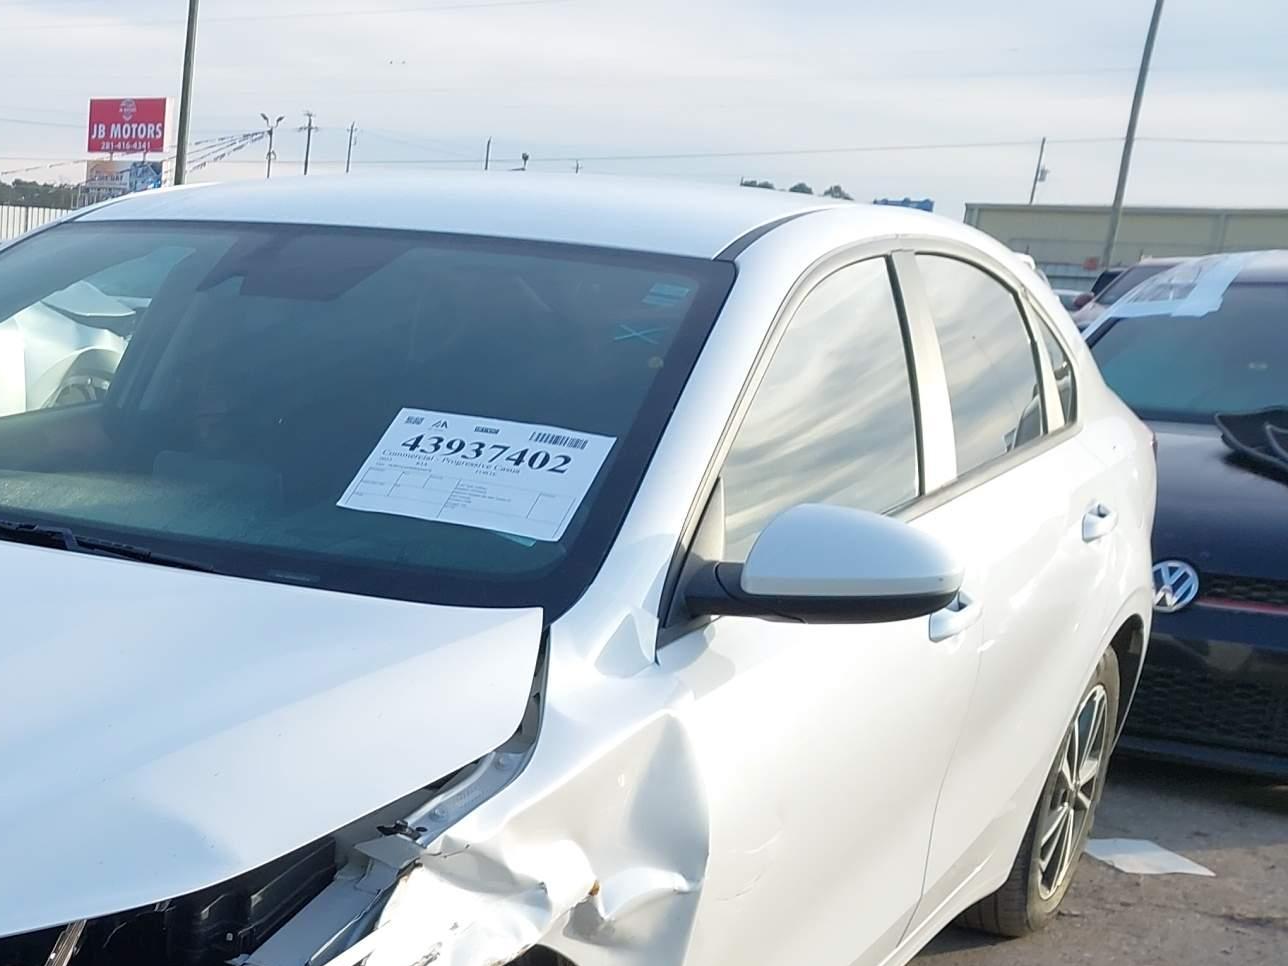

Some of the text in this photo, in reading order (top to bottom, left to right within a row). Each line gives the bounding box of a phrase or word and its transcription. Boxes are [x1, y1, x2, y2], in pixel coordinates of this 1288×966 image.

[91, 122, 163, 139] JB MOTORS
[400, 433, 573, 474] 43937402
